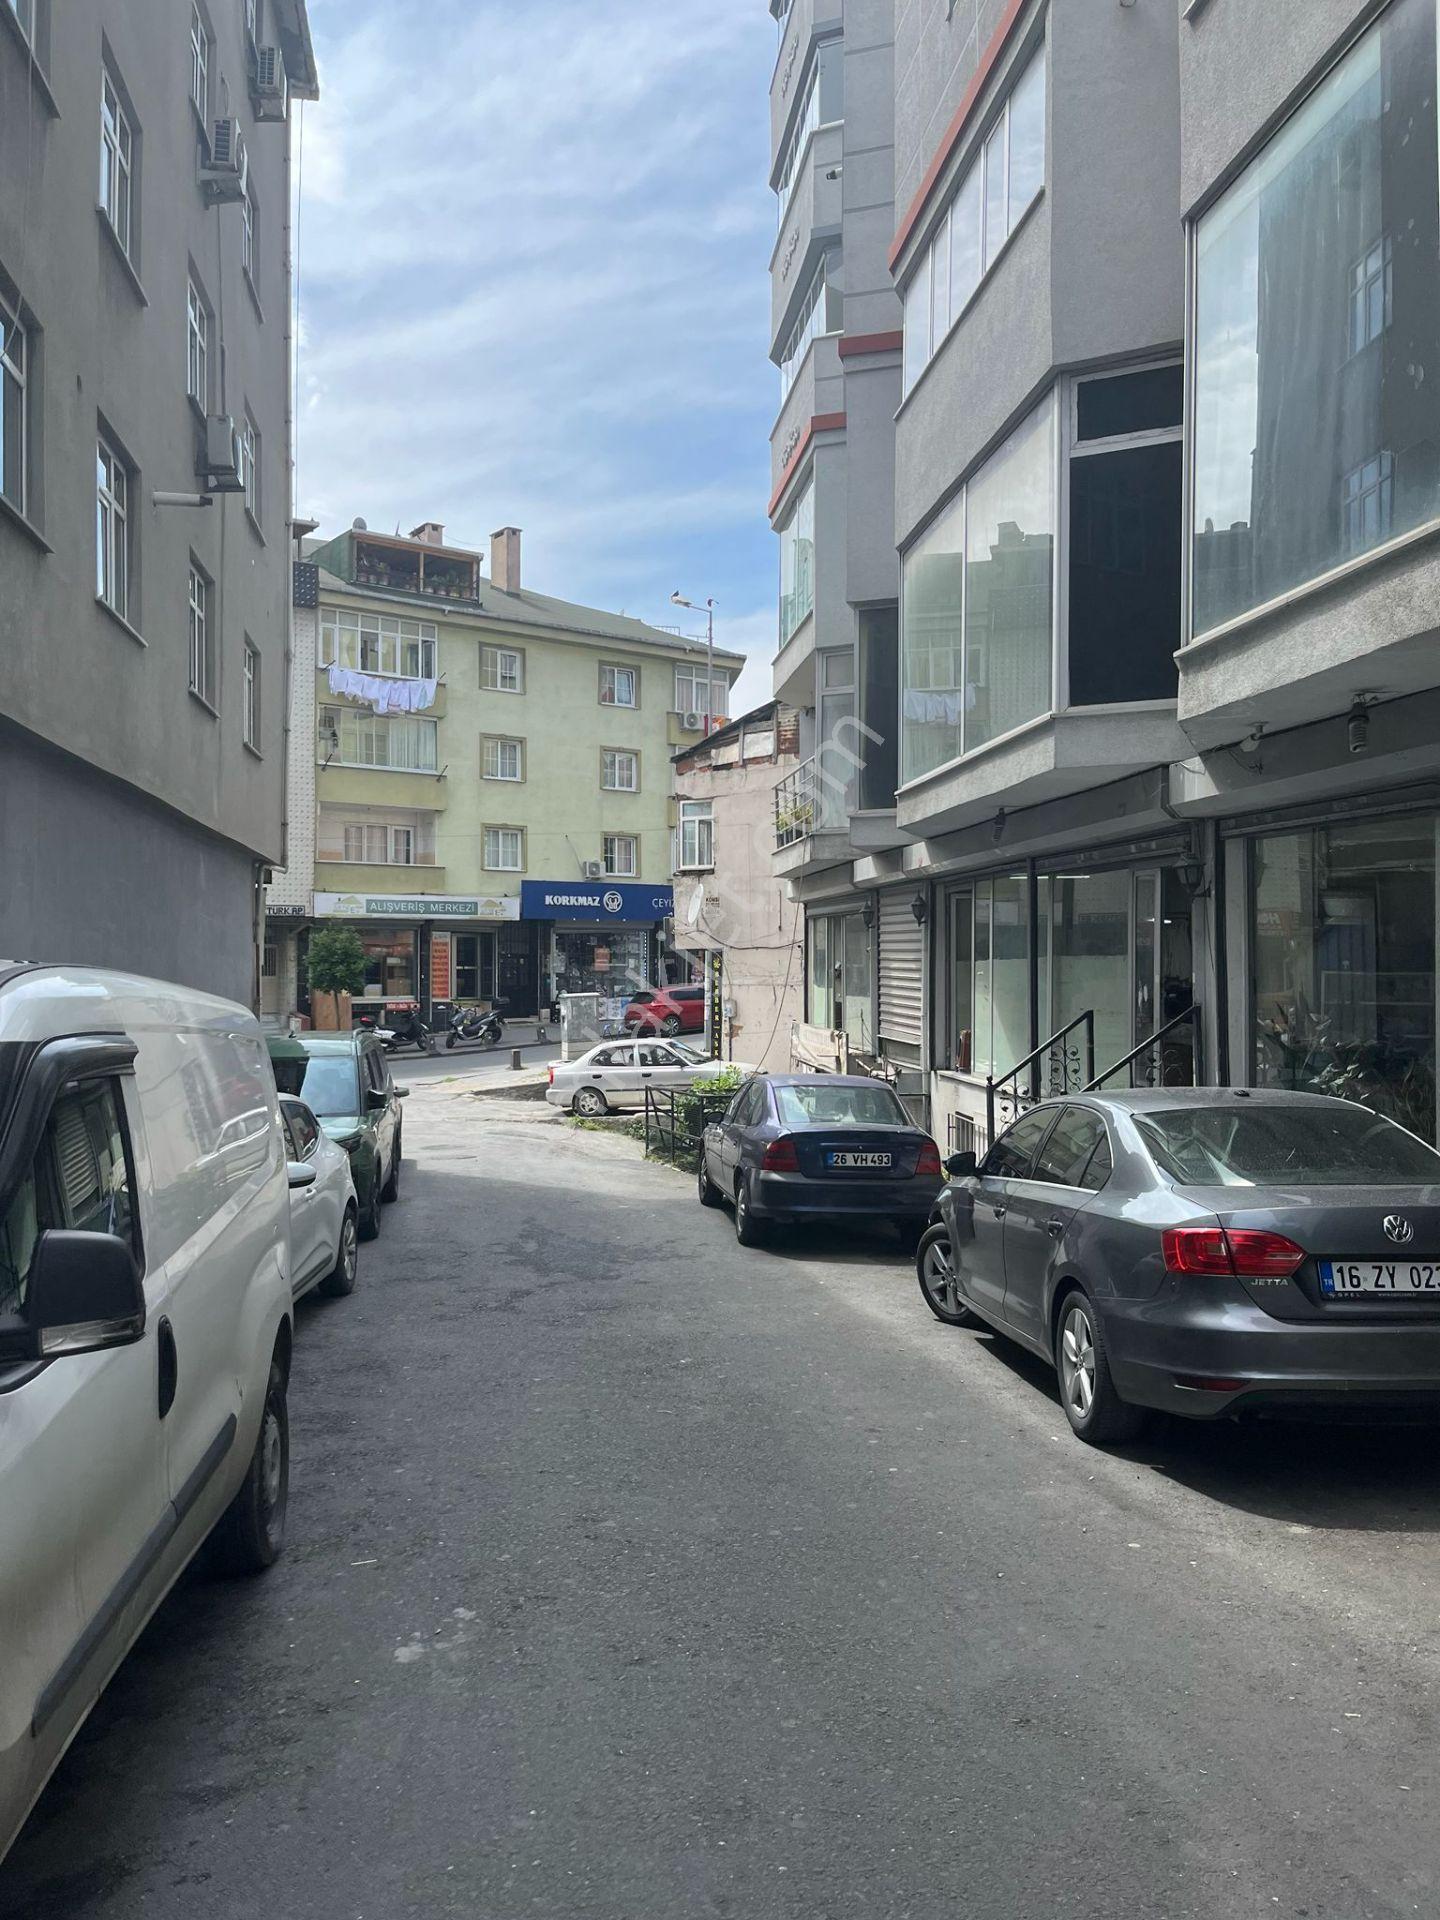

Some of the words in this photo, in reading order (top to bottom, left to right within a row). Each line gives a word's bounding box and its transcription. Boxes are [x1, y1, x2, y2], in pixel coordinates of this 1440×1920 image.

[545, 894, 601, 907] KORKMAZ
[430, 903, 475, 913] MERKEZİ
[834, 1154, 847, 1165] 26
[852, 1154, 868, 1165] VH
[871, 1154, 890, 1165] 493
[1251, 1278, 1289, 1286] JETTA
[1323, 1278, 1333, 1286] TR
[1336, 1266, 1361, 1288] 16
[1371, 1266, 1396, 1288] ZY
